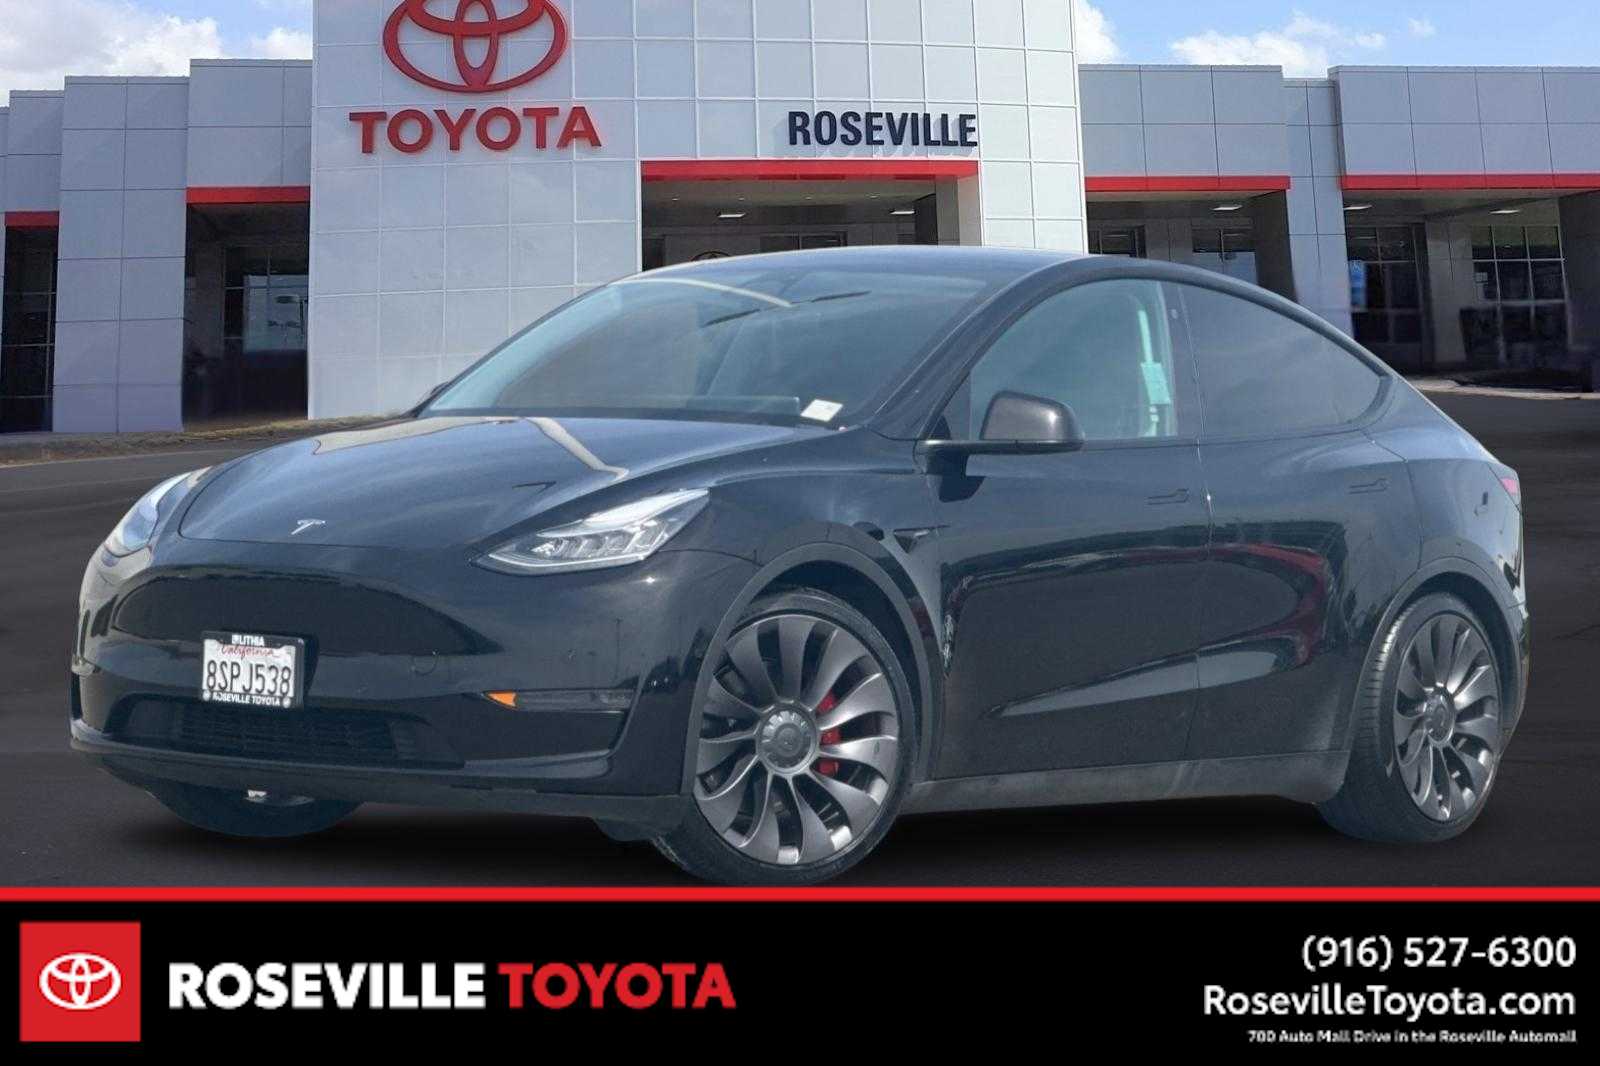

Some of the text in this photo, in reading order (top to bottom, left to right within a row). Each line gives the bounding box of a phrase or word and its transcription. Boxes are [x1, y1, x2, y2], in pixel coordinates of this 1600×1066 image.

[349, 106, 602, 154] TOYOTA
[788, 110, 977, 148] ROSEVILLE
[206, 659, 292, 697] 8SPJ538
[212, 692, 281, 706] ROSEVILLE TOYOTA
